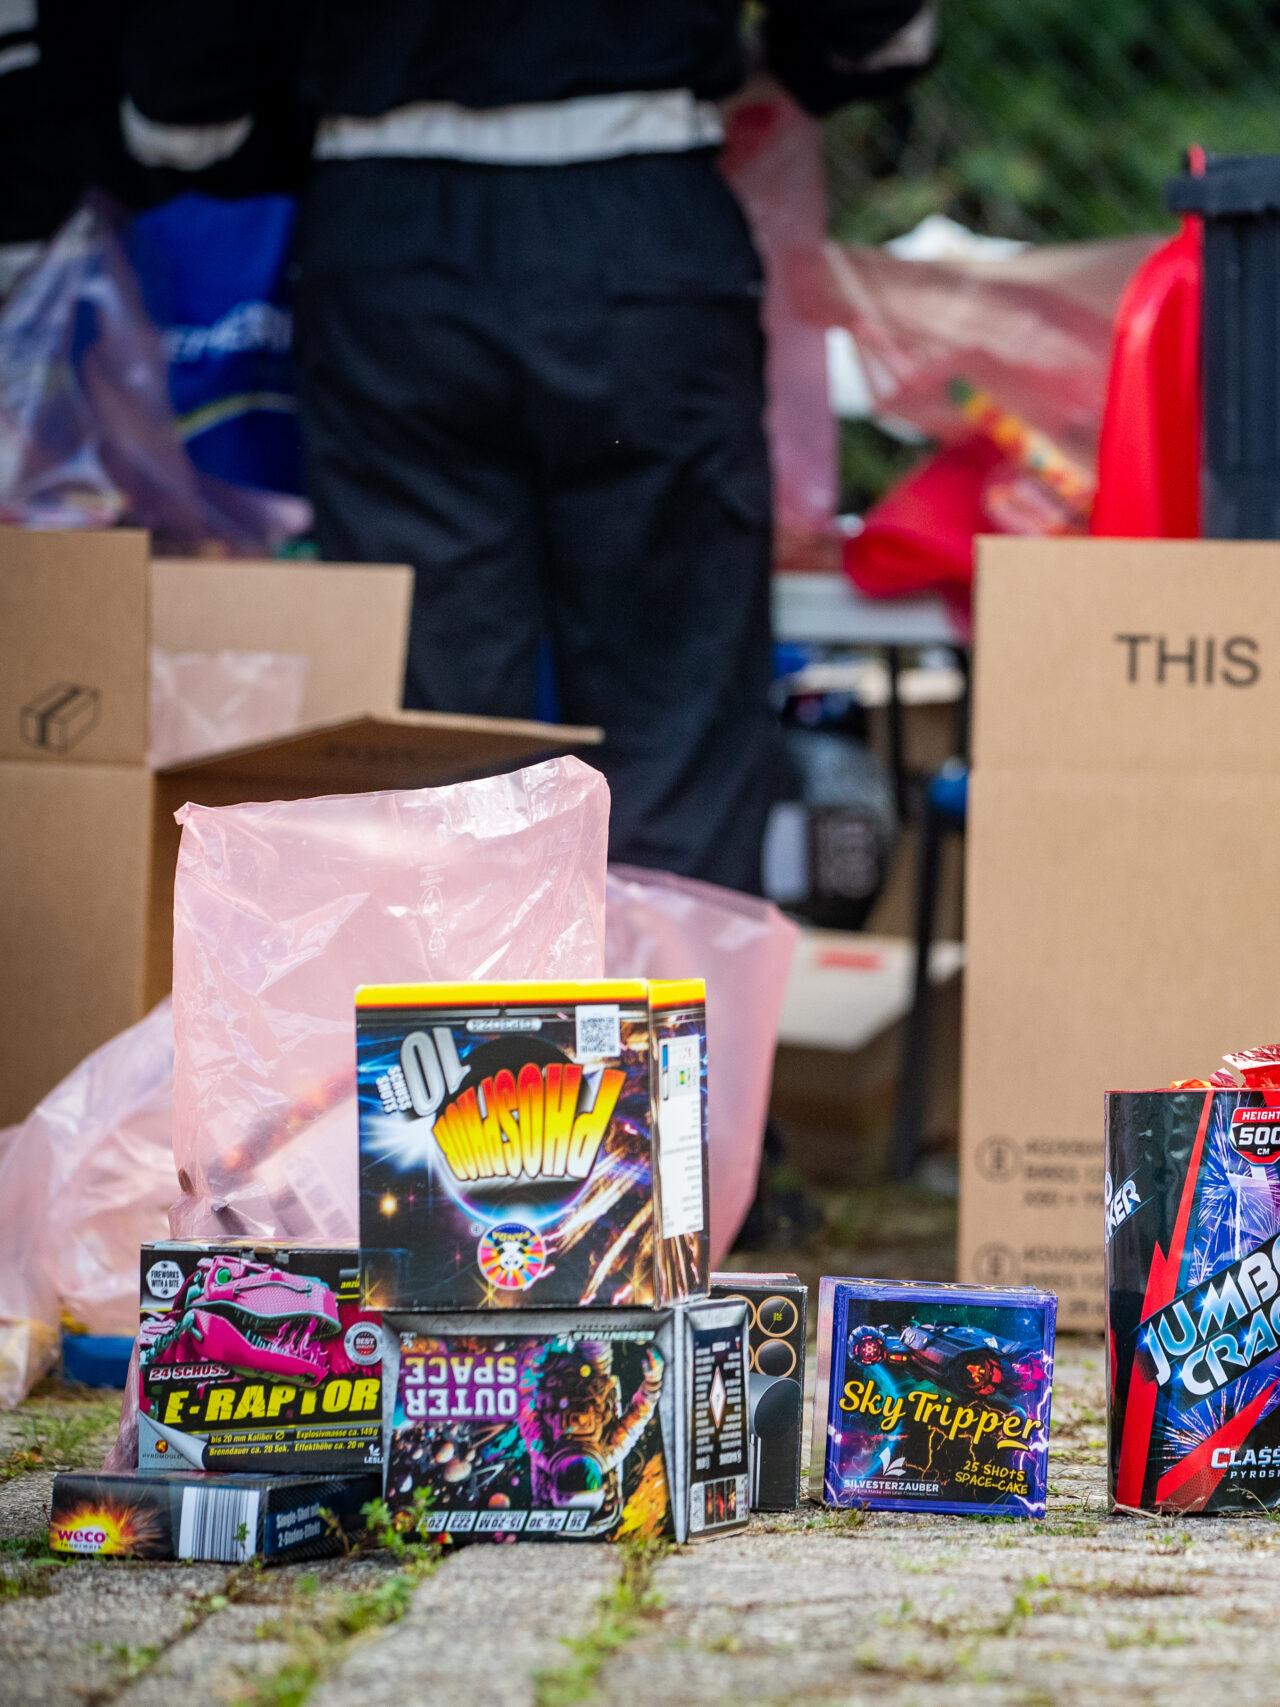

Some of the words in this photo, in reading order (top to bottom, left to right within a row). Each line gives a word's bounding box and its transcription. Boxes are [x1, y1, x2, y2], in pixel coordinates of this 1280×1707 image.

[1114, 633, 1261, 687] THIS
[401, 1027, 471, 1117] 10
[375, 1074, 397, 1114] SHOTS
[387, 1065, 412, 1112] SCHUSS
[432, 1062, 627, 1181] PHOSPHOR
[1257, 1147, 1270, 1156] CM
[492, 1230, 530, 1242] PANDA
[151, 1271, 179, 1280] FIREWORKS
[151, 1279, 162, 1288] WITH
[163, 1279, 167, 1288] A
[168, 1279, 180, 1289] BITE
[572, 1331, 655, 1341] ESSENTIALS
[151, 1368, 170, 1380] 24
[173, 1363, 230, 1378] SCHUSS
[404, 1357, 517, 1385] SPACE
[164, 1378, 381, 1424] E-RAPTOR
[405, 1388, 517, 1417] OUTER
[839, 1380, 907, 1431] Sky
[907, 1390, 1043, 1445] Tripper
[211, 1436, 222, 1444] bis
[223, 1435, 232, 1443] 20
[234, 1435, 246, 1443] mm
[248, 1433, 273, 1442] Kaliber
[209, 1446, 249, 1456] Brenndauer
[251, 1446, 262, 1454] ca.
[264, 1445, 273, 1453] 20
[275, 1444, 290, 1453] Sek.
[294, 1443, 333, 1453] Effekthöhe
[347, 1441, 357, 1449] 20
[963, 1460, 979, 1473] 25
[844, 1480, 939, 1493] SILVESTERZAUBER
[955, 1471, 1029, 1495] SPACE-CAKE
[58, 1529, 106, 1543] weco
